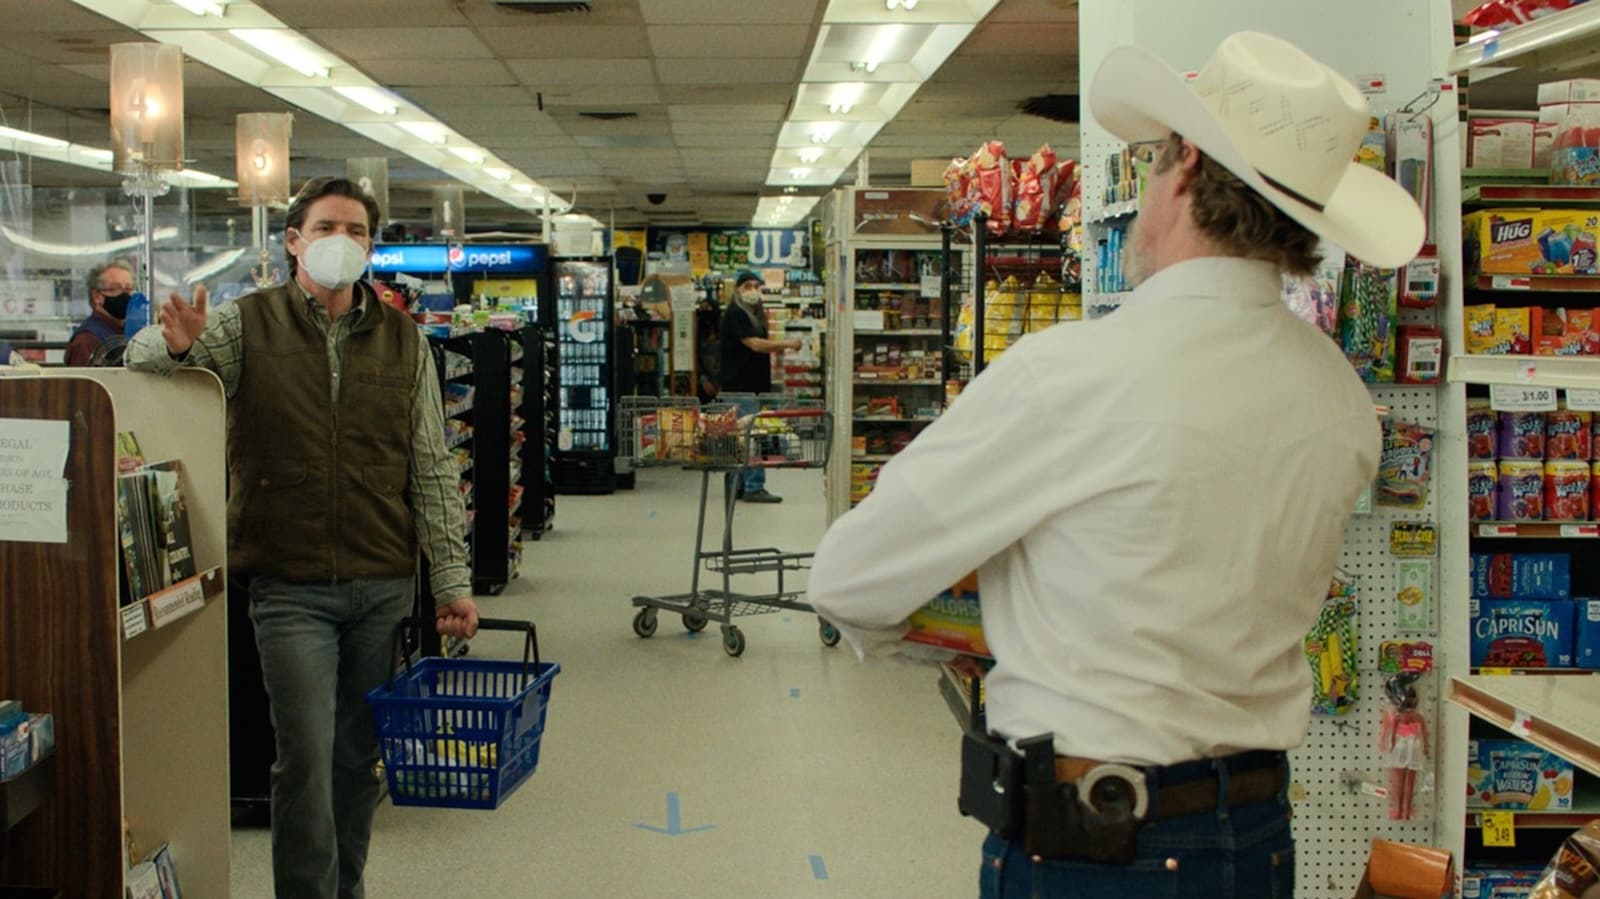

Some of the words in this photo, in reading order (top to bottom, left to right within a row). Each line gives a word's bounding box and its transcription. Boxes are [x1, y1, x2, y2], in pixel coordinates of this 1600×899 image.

[128, 78, 148, 123] 4
[1496, 223, 1531, 243] HUG
[468, 250, 512, 267] pepsi
